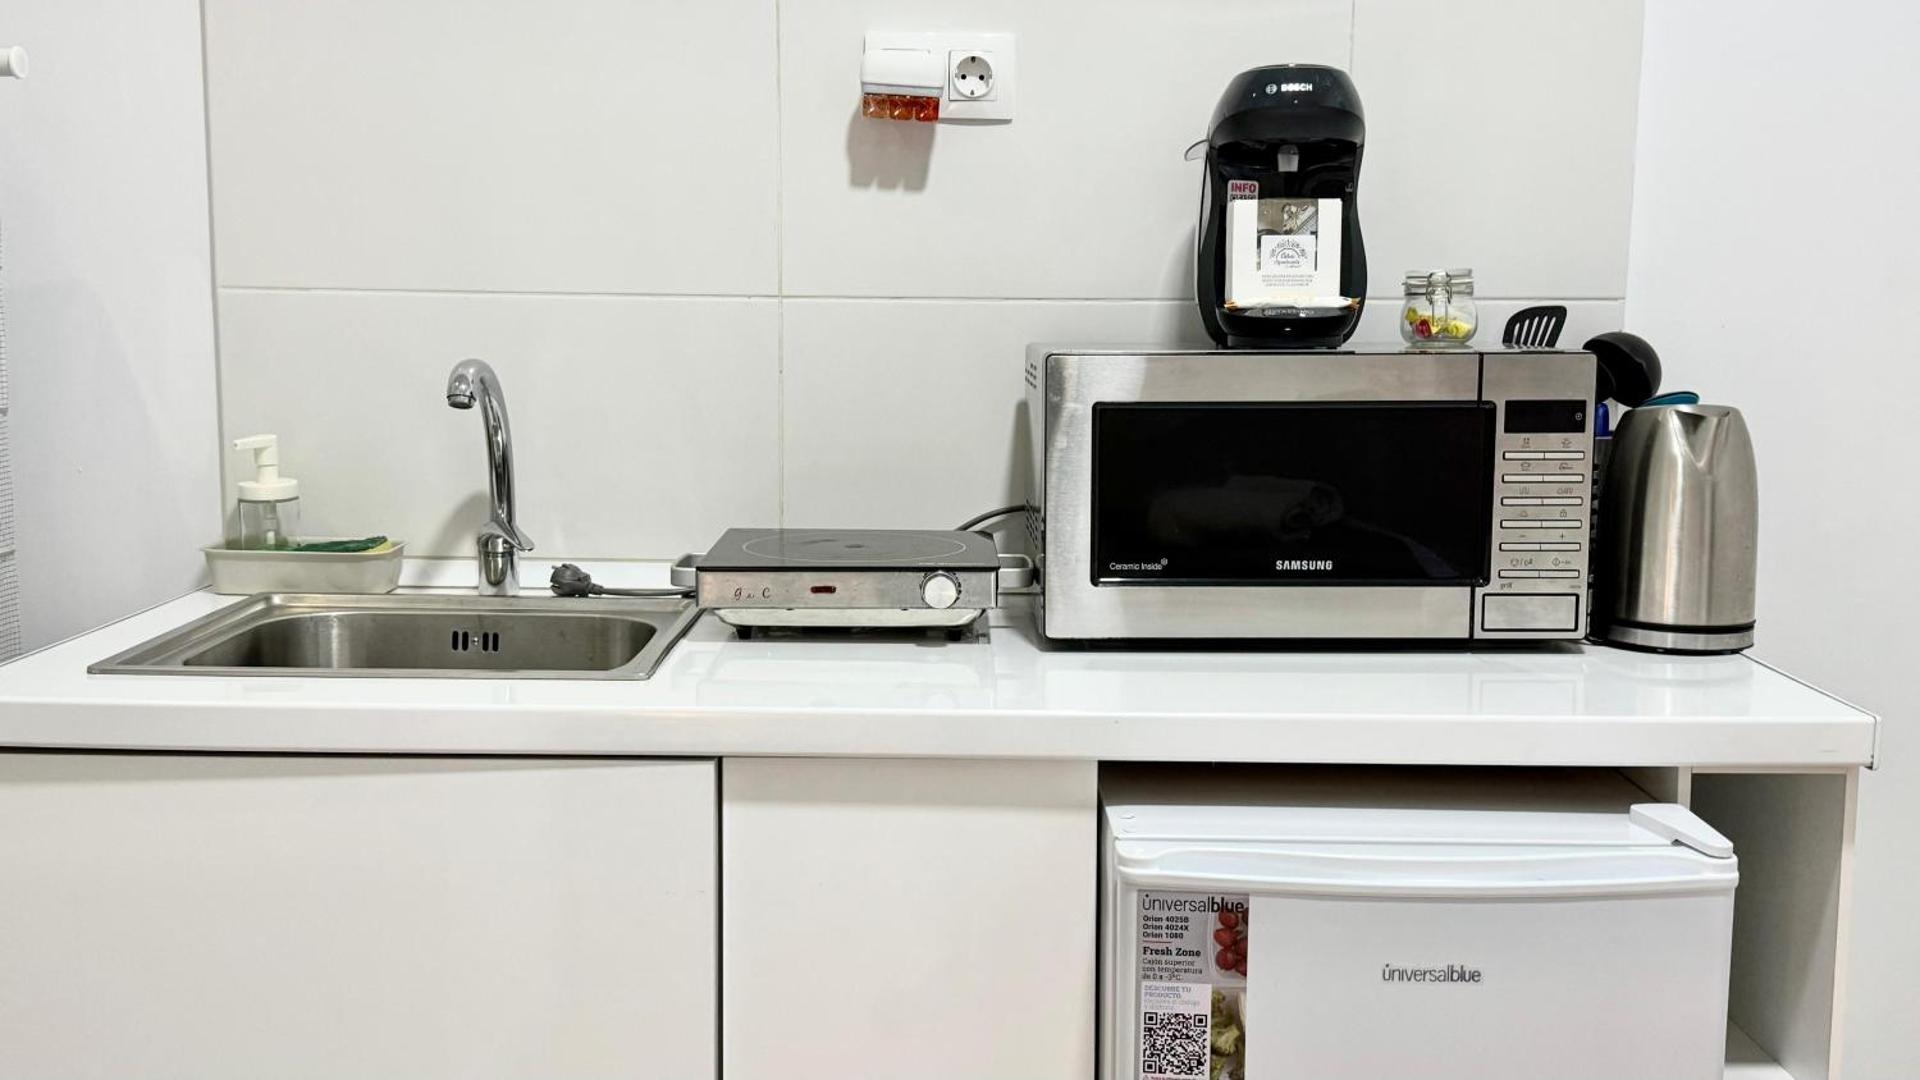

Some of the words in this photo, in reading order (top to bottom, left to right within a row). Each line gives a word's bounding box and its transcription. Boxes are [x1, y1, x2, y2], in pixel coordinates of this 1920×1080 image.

[1281, 83, 1313, 91] BOSCH
[1231, 182, 1256, 193] INFO
[1110, 562, 1140, 570] Ceramic
[1275, 560, 1333, 570] SAMSUNG
[1143, 915, 1163, 923] Orion
[1143, 923, 1163, 931] Orion
[1143, 931, 1163, 939] Orion
[1143, 946, 1173, 956] Fresh
[1175, 948, 1201, 957] Zone
